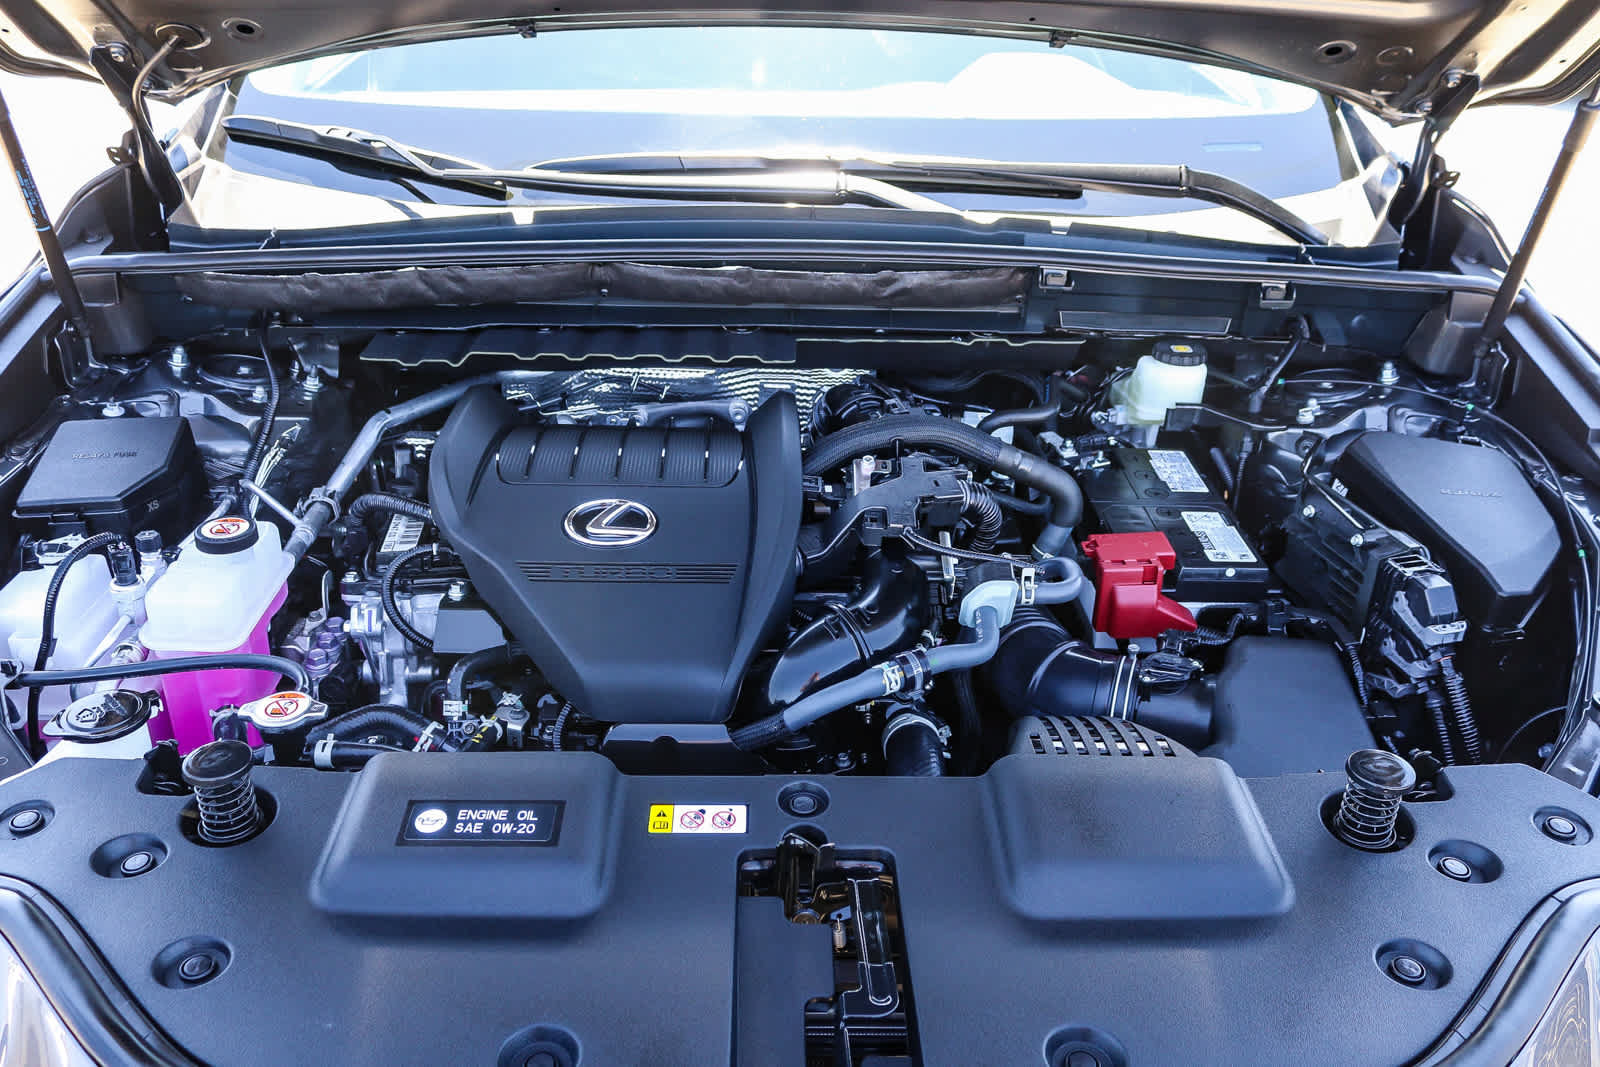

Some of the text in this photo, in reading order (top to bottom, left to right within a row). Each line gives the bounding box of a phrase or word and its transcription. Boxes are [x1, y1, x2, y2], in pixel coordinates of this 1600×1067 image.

[551, 566, 673, 579] TURBO
[457, 809, 538, 821] ENGINE OIL
[454, 822, 536, 833] SAE 0W-20
